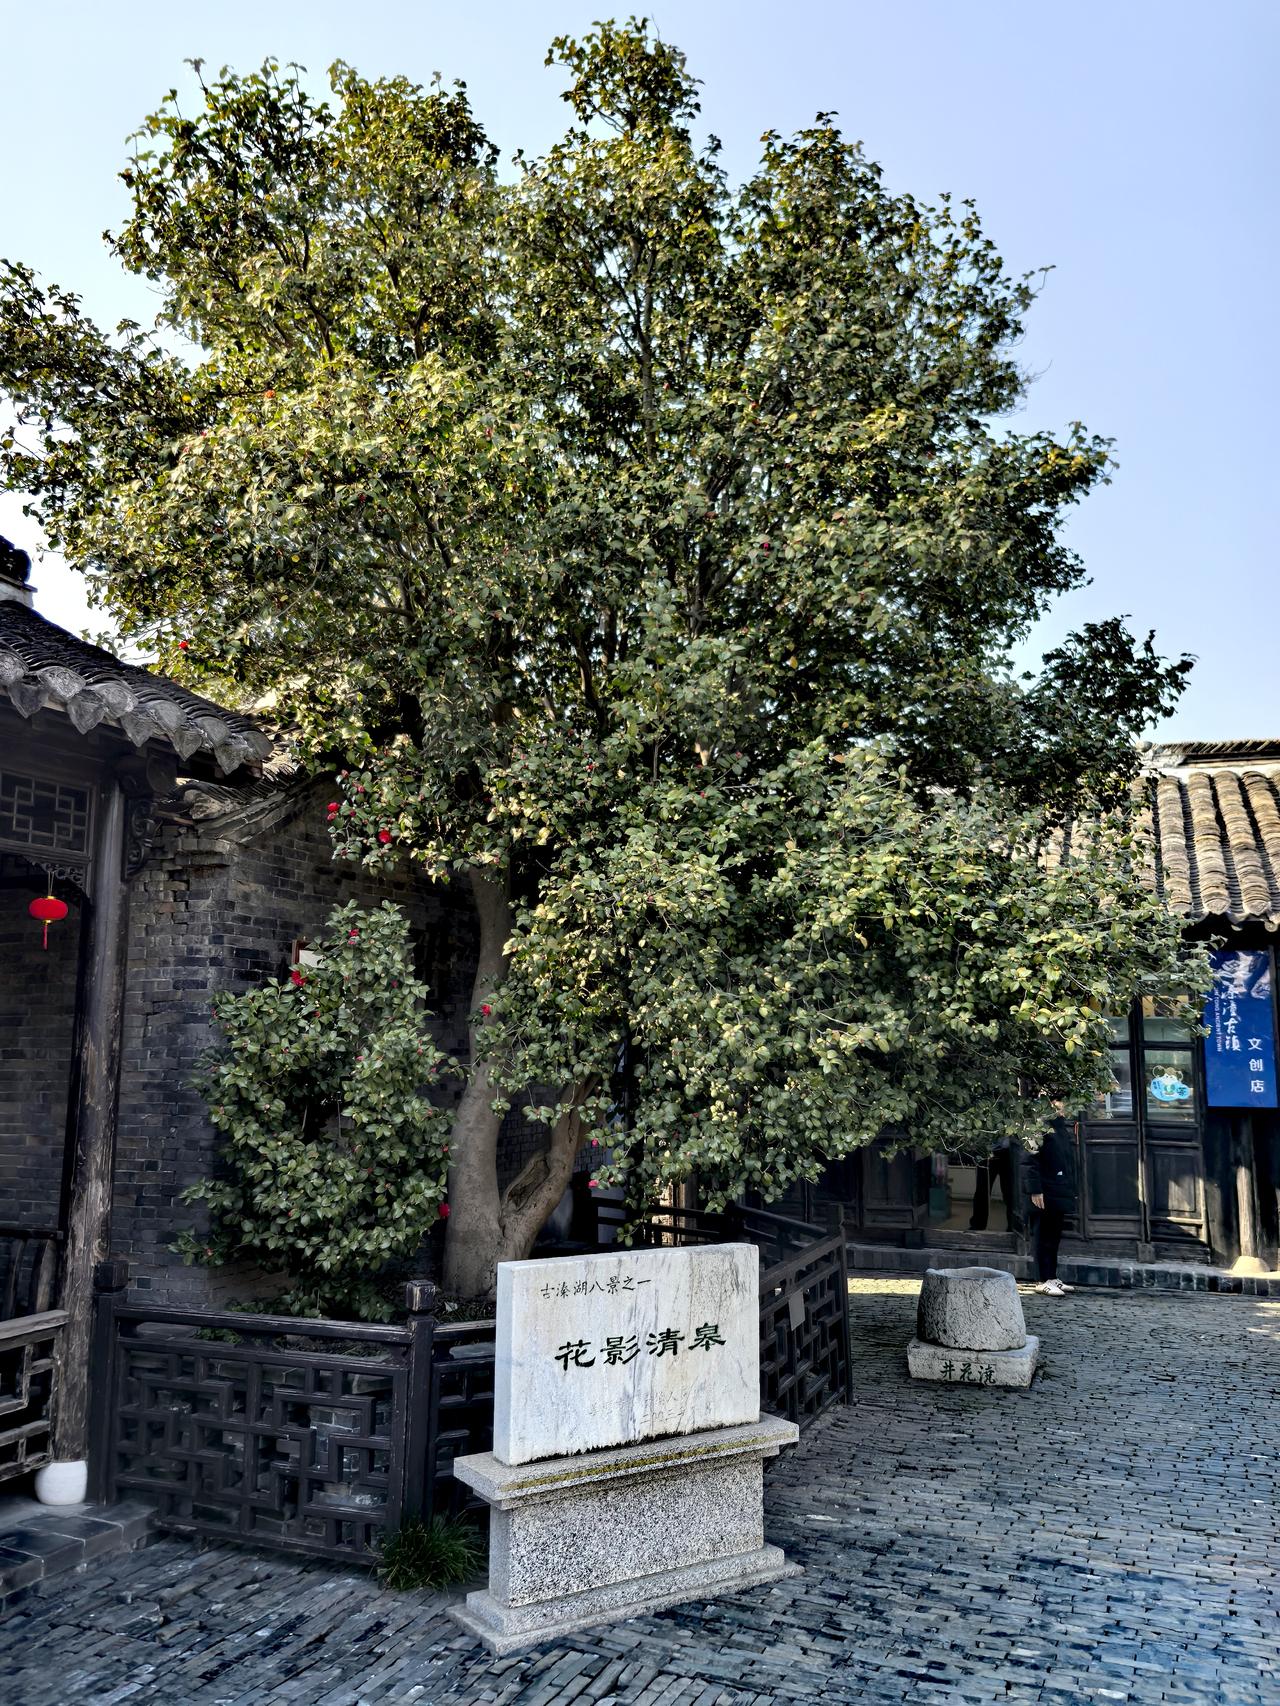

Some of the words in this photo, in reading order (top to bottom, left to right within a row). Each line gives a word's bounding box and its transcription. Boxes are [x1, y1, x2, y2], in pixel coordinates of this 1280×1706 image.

[1248, 1038, 1264, 1093] 文创店
[540, 1276, 652, 1299] 古溱湖八景之一
